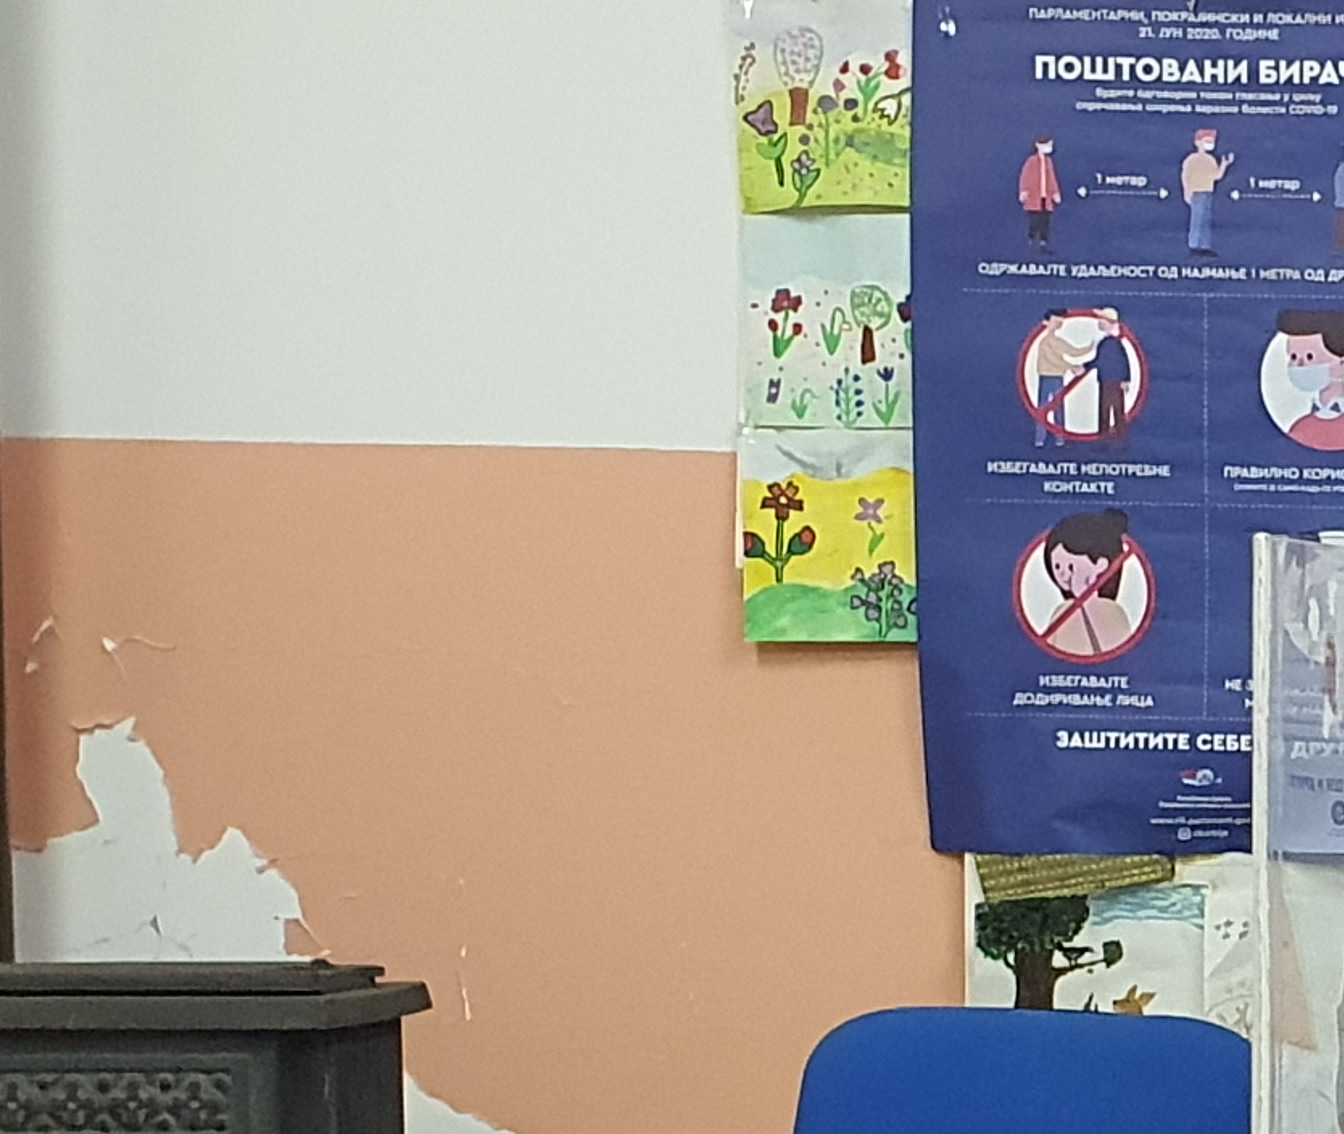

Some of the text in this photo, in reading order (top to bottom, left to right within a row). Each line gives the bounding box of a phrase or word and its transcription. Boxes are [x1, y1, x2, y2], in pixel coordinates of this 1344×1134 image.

[1035, 55, 1248, 83] ПОШТОВАНИ
[1105, 175, 1147, 186] метар
[1258, 179, 1301, 190] метар
[978, 262, 1067, 276] ОДРЖАВАЈТЕ
[1070, 264, 1156, 278] УДАЉЕНОСТ
[1157, 265, 1179, 279] ОД
[1259, 267, 1301, 279] МЕТРА
[1303, 268, 1326, 281] ОД
[987, 461, 1171, 476] ИЗБЕГАВАЈТЕ НЕПОТРЕБНЕ
[1224, 466, 1300, 478] ПРАВИЛНО
[1043, 480, 1115, 493] КОНТАКТЕ
[1039, 674, 1129, 688] ИЗБЕГАВАЈТЕ
[1013, 692, 1154, 707] ДОДИРИВАЊЕ ЛИЦА
[1056, 730, 1190, 749] ЗАШТИТИТЕ
[1196, 733, 1252, 751] СЕБЕ
